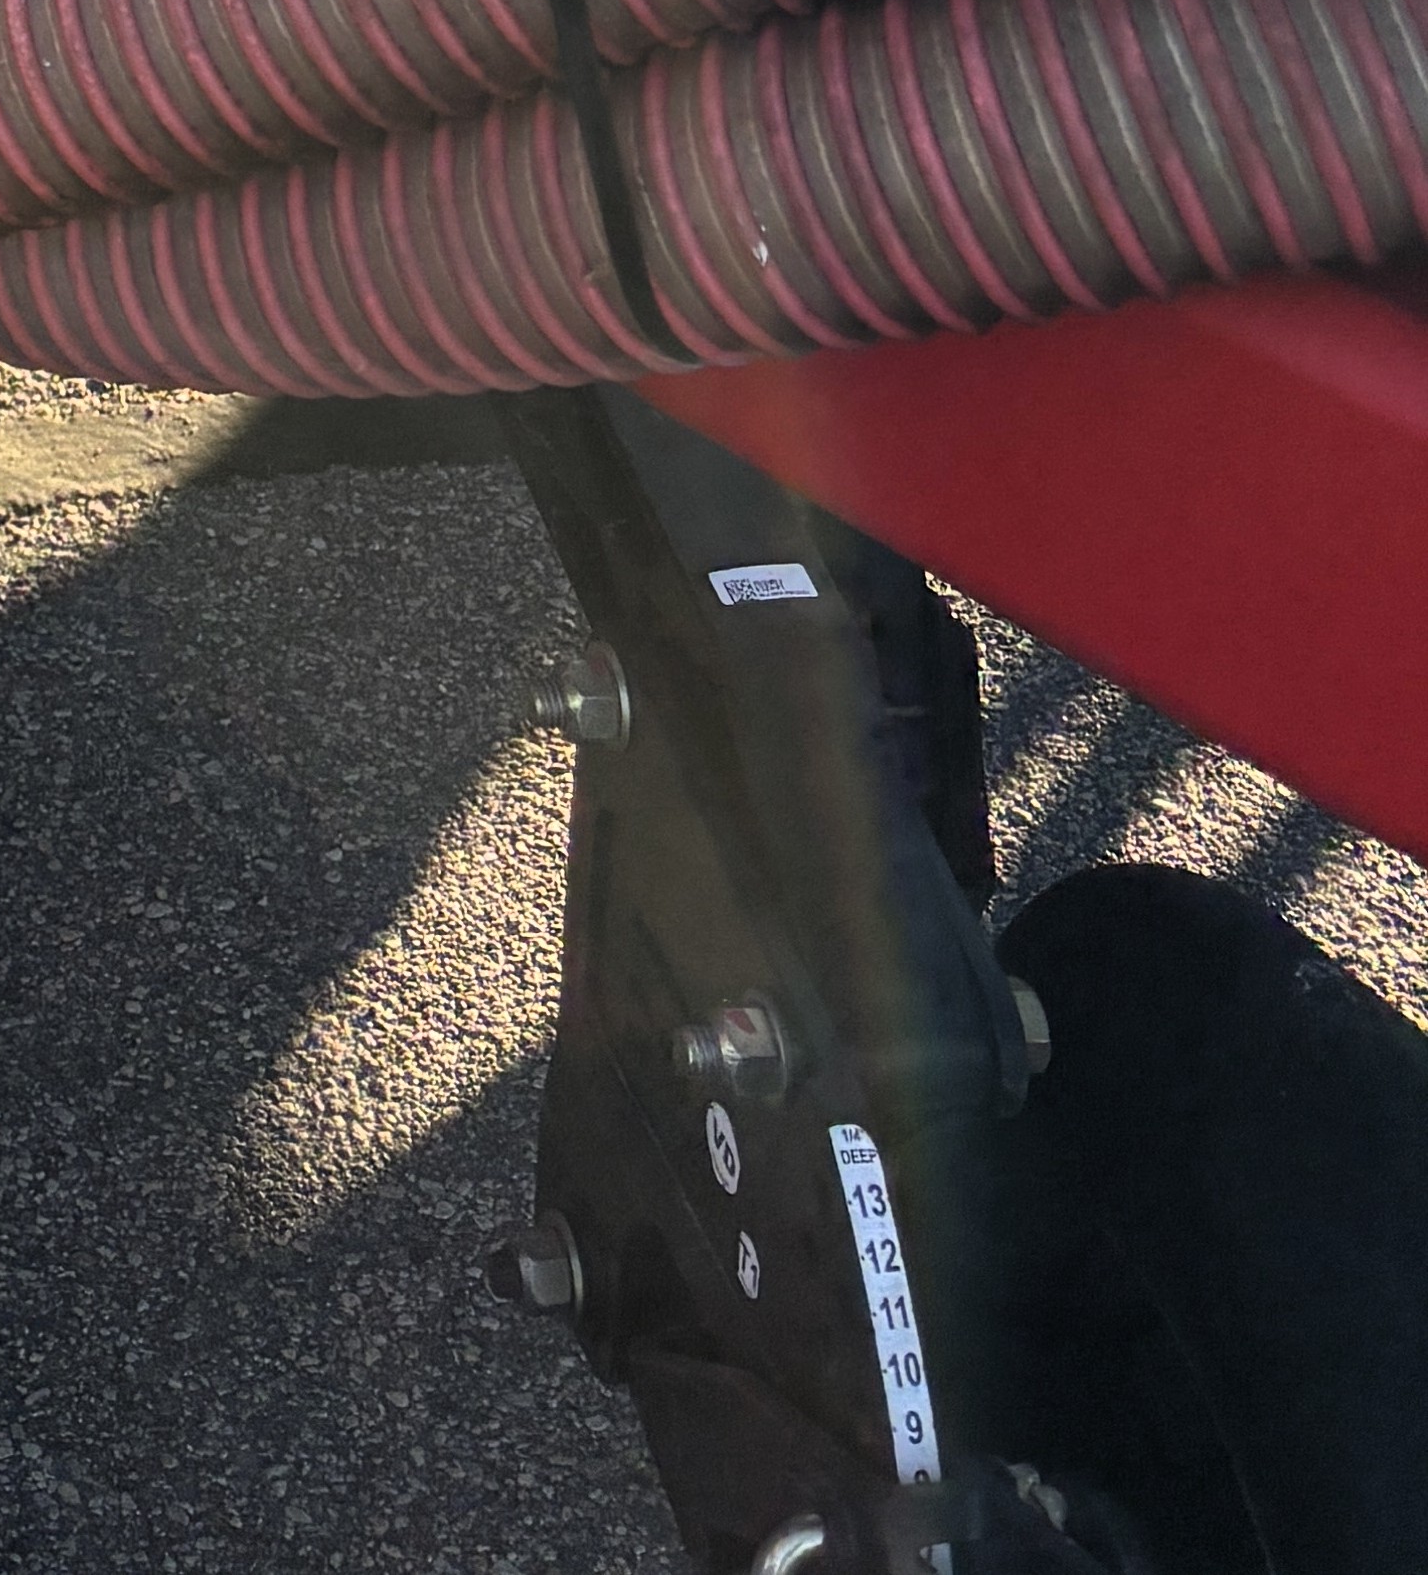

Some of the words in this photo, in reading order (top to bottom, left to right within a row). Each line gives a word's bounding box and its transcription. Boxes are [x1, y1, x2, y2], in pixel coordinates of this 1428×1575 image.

[841, 1149, 877, 1165] DEEP
[852, 1184, 887, 1218] 13
[865, 1239, 900, 1274] 12
[879, 1295, 910, 1330] 11
[888, 1352, 921, 1388] 10
[905, 1410, 924, 1445] 9
